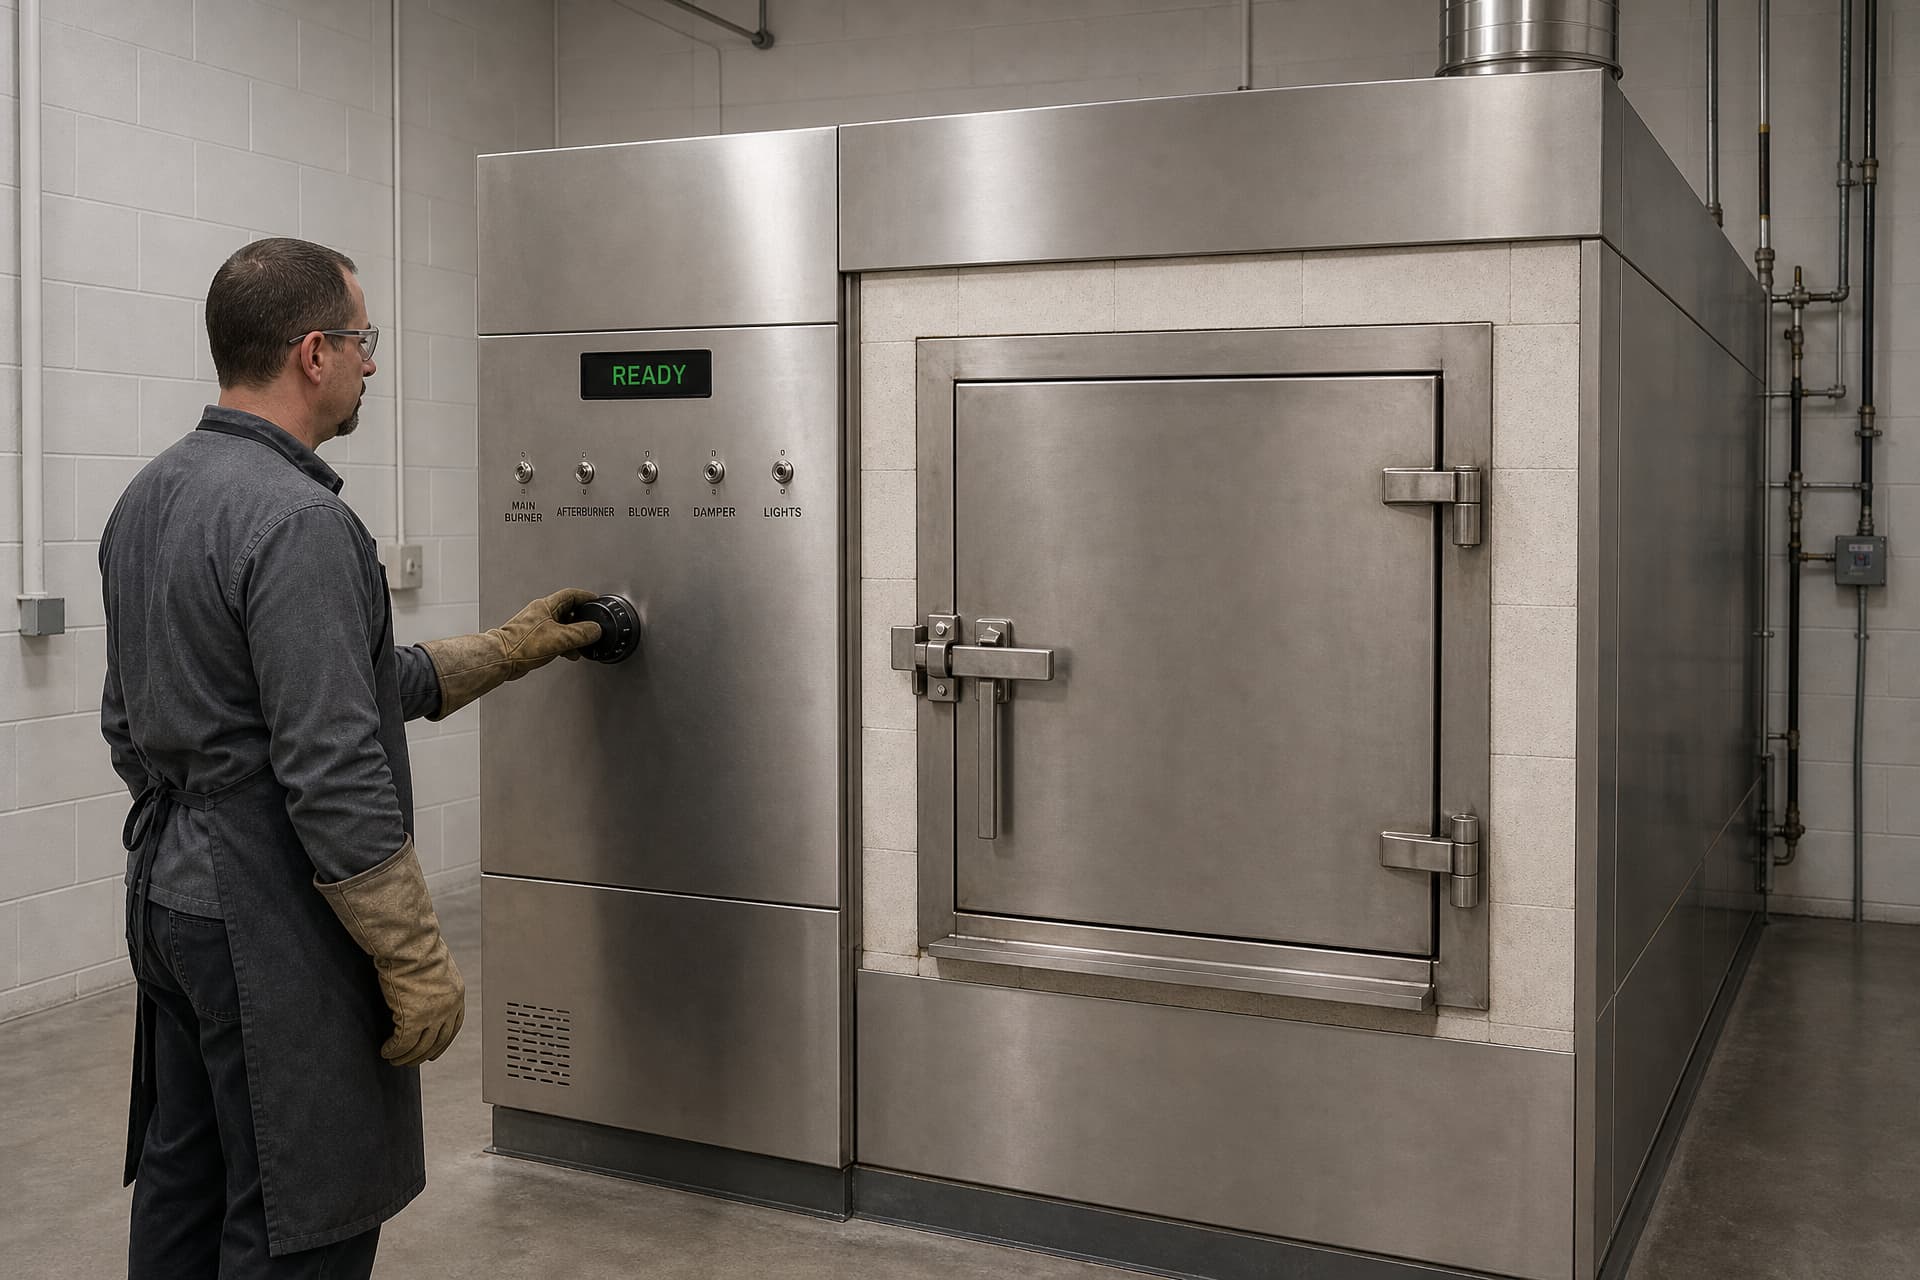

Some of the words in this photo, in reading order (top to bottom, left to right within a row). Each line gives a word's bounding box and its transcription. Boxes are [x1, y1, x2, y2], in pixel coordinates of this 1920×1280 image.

[612, 364, 687, 386] READY
[511, 501, 536, 511] MAIN
[556, 507, 615, 517] AFTERBURNER
[628, 507, 670, 517] BLOWER
[693, 507, 736, 517] DAMPER
[763, 507, 802, 518] LIGHTS
[504, 512, 543, 523] BURNER
